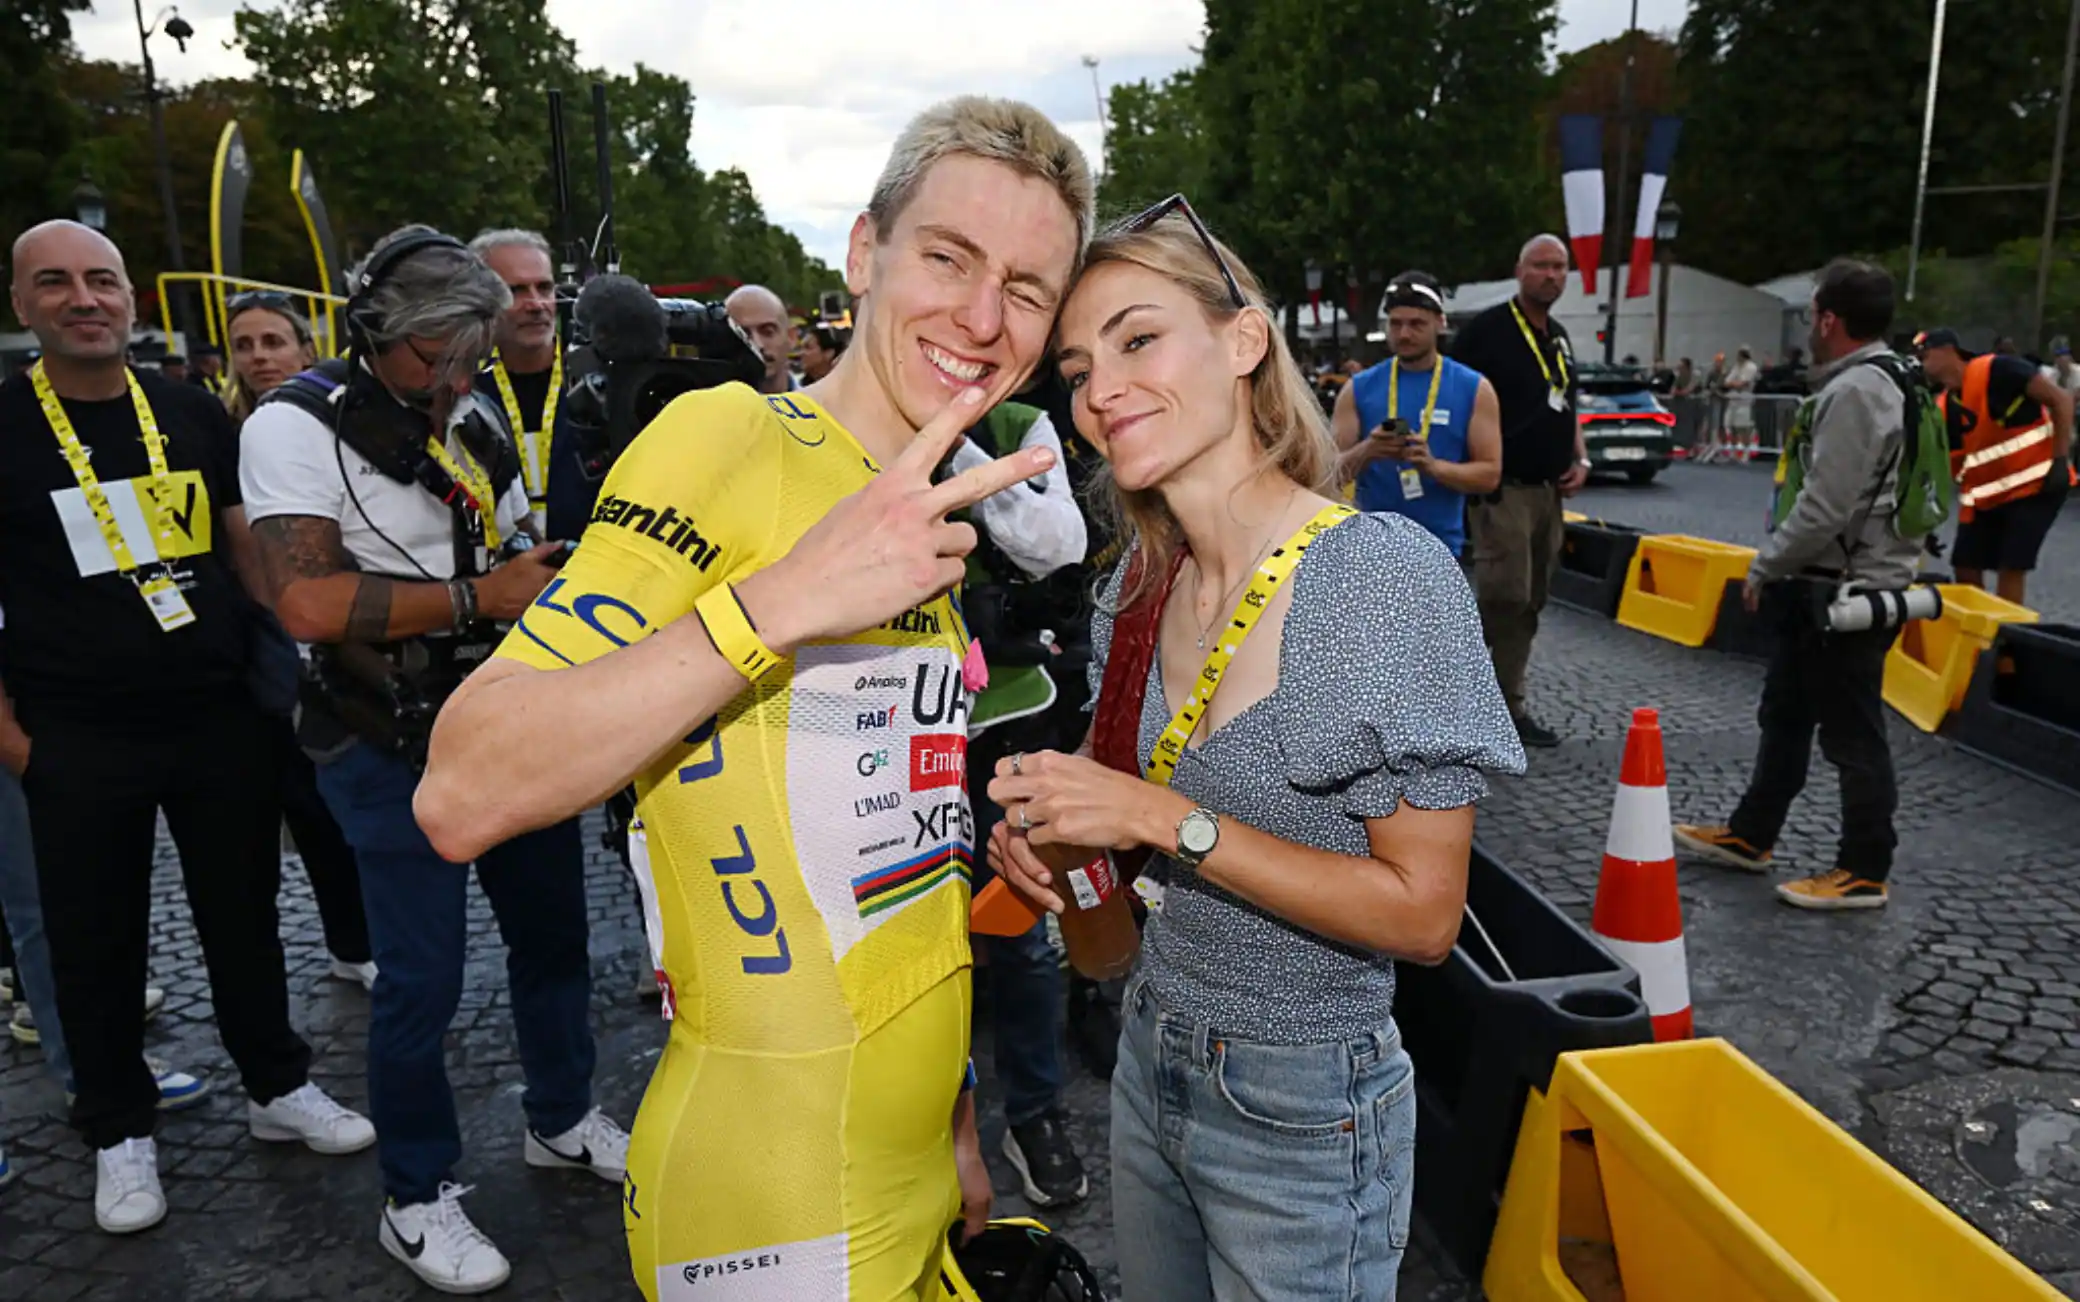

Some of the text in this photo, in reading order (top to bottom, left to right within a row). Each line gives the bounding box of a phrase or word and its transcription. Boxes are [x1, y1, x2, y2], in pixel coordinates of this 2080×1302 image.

[535, 578, 659, 648] LC
[857, 749, 889, 777] G42
[710, 824, 793, 975] LCL
[704, 1253, 781, 1278] PISSEI
